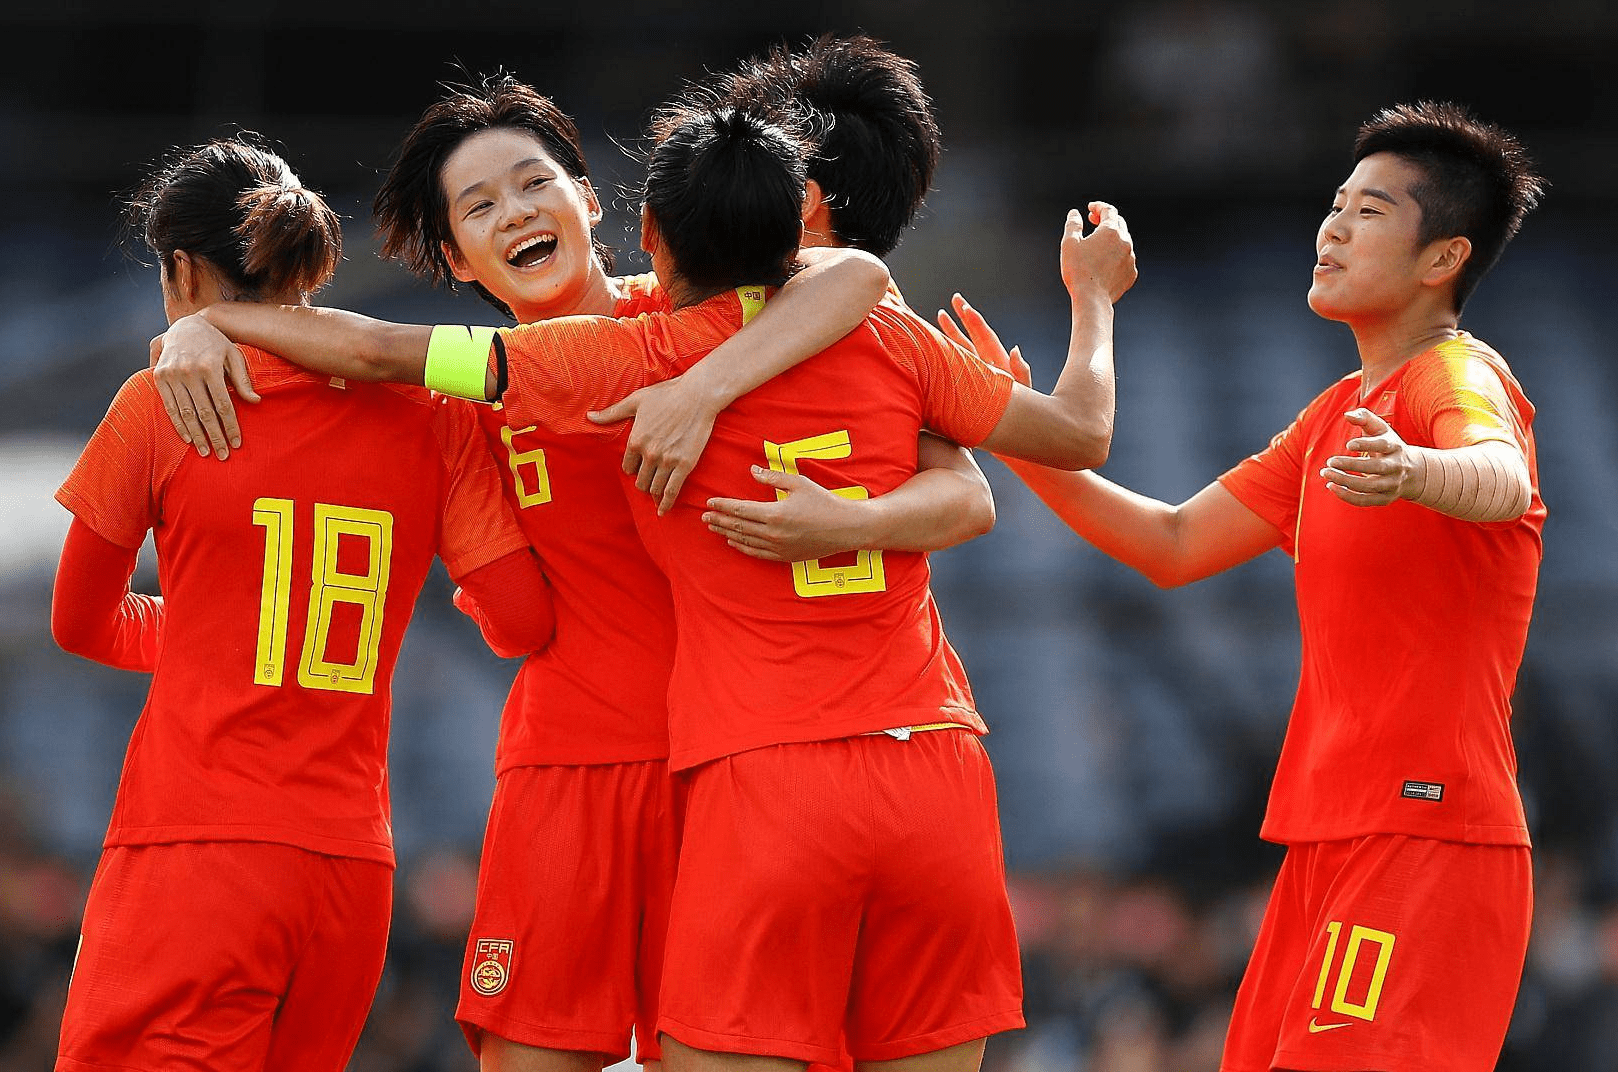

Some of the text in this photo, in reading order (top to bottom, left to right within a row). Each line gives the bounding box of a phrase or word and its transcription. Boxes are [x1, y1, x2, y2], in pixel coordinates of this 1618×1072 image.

[744, 291, 761, 301] 中国
[500, 425, 552, 510] 6
[252, 497, 394, 695] 18
[479, 942, 510, 954] CFA
[1311, 921, 1396, 1022] 10
